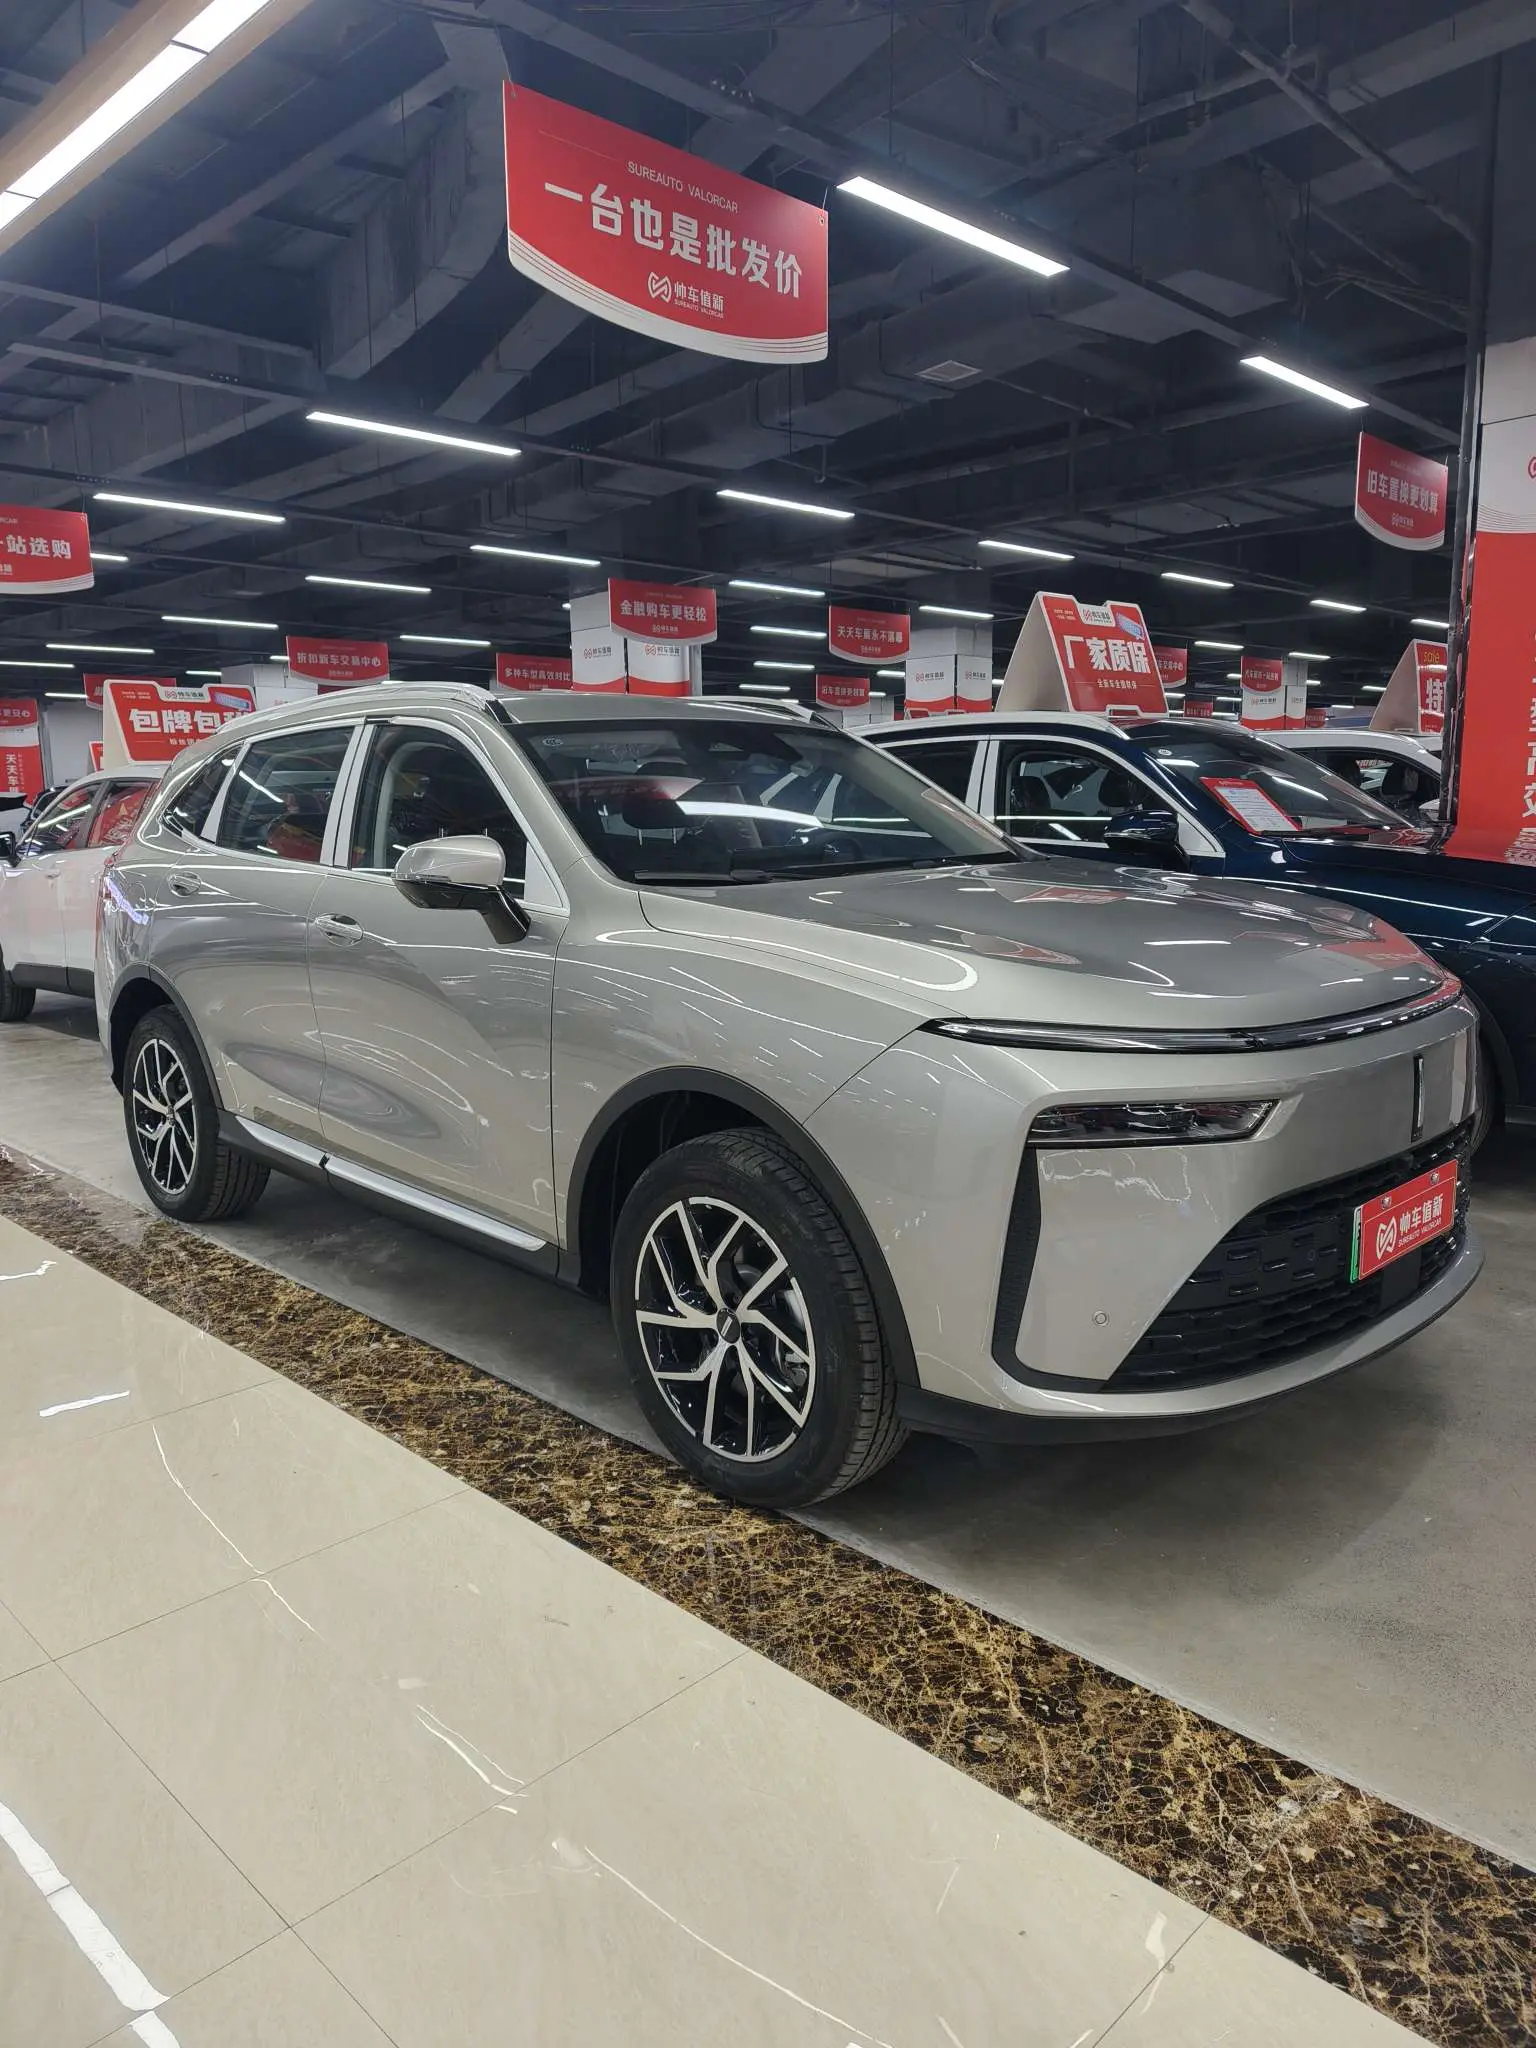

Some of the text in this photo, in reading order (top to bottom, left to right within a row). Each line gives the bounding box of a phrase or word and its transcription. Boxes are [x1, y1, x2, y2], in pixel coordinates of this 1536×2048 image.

[627, 160, 739, 213] SUREAUTO VALORCAR
[544, 182, 802, 298] 一台也是批发价
[674, 281, 725, 313] 帅车值新
[1367, 468, 1440, 517] 旧车置换更划算
[0, 534, 72, 560] 站选购
[621, 599, 707, 622] 金融购车更轻松
[1063, 634, 1151, 674] 厂家质保
[1425, 678, 1446, 714] 特
[1400, 1193, 1444, 1236] 帅车值新
